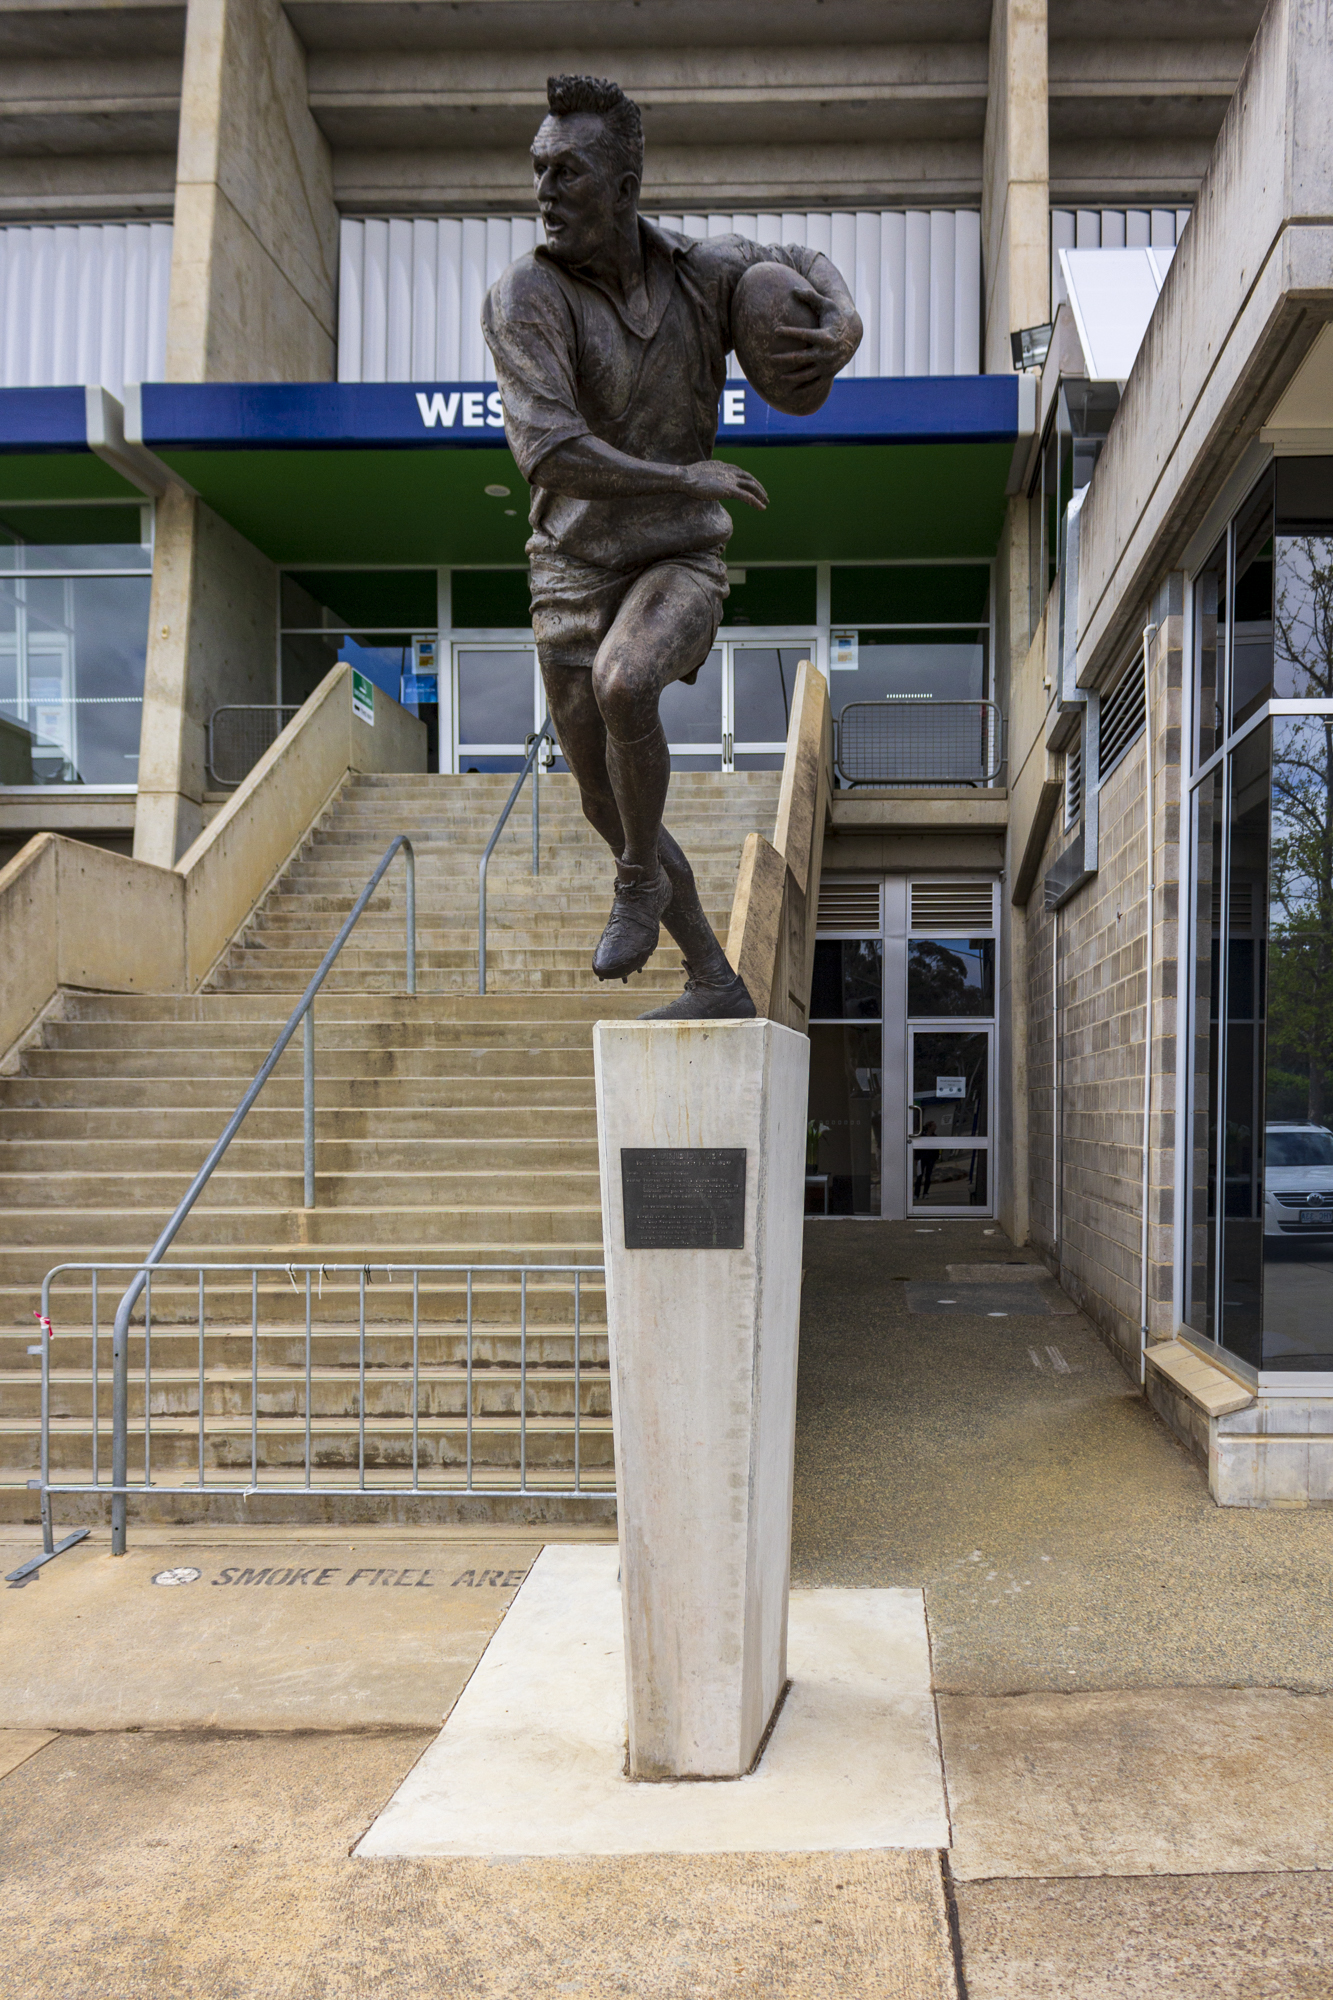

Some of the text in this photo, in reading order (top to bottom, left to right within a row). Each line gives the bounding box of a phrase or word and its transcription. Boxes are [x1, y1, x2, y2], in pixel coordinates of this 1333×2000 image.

[415, 389, 746, 427] WES E
[211, 1567, 341, 1586] SMOKE
[346, 1568, 440, 1587] FREE
